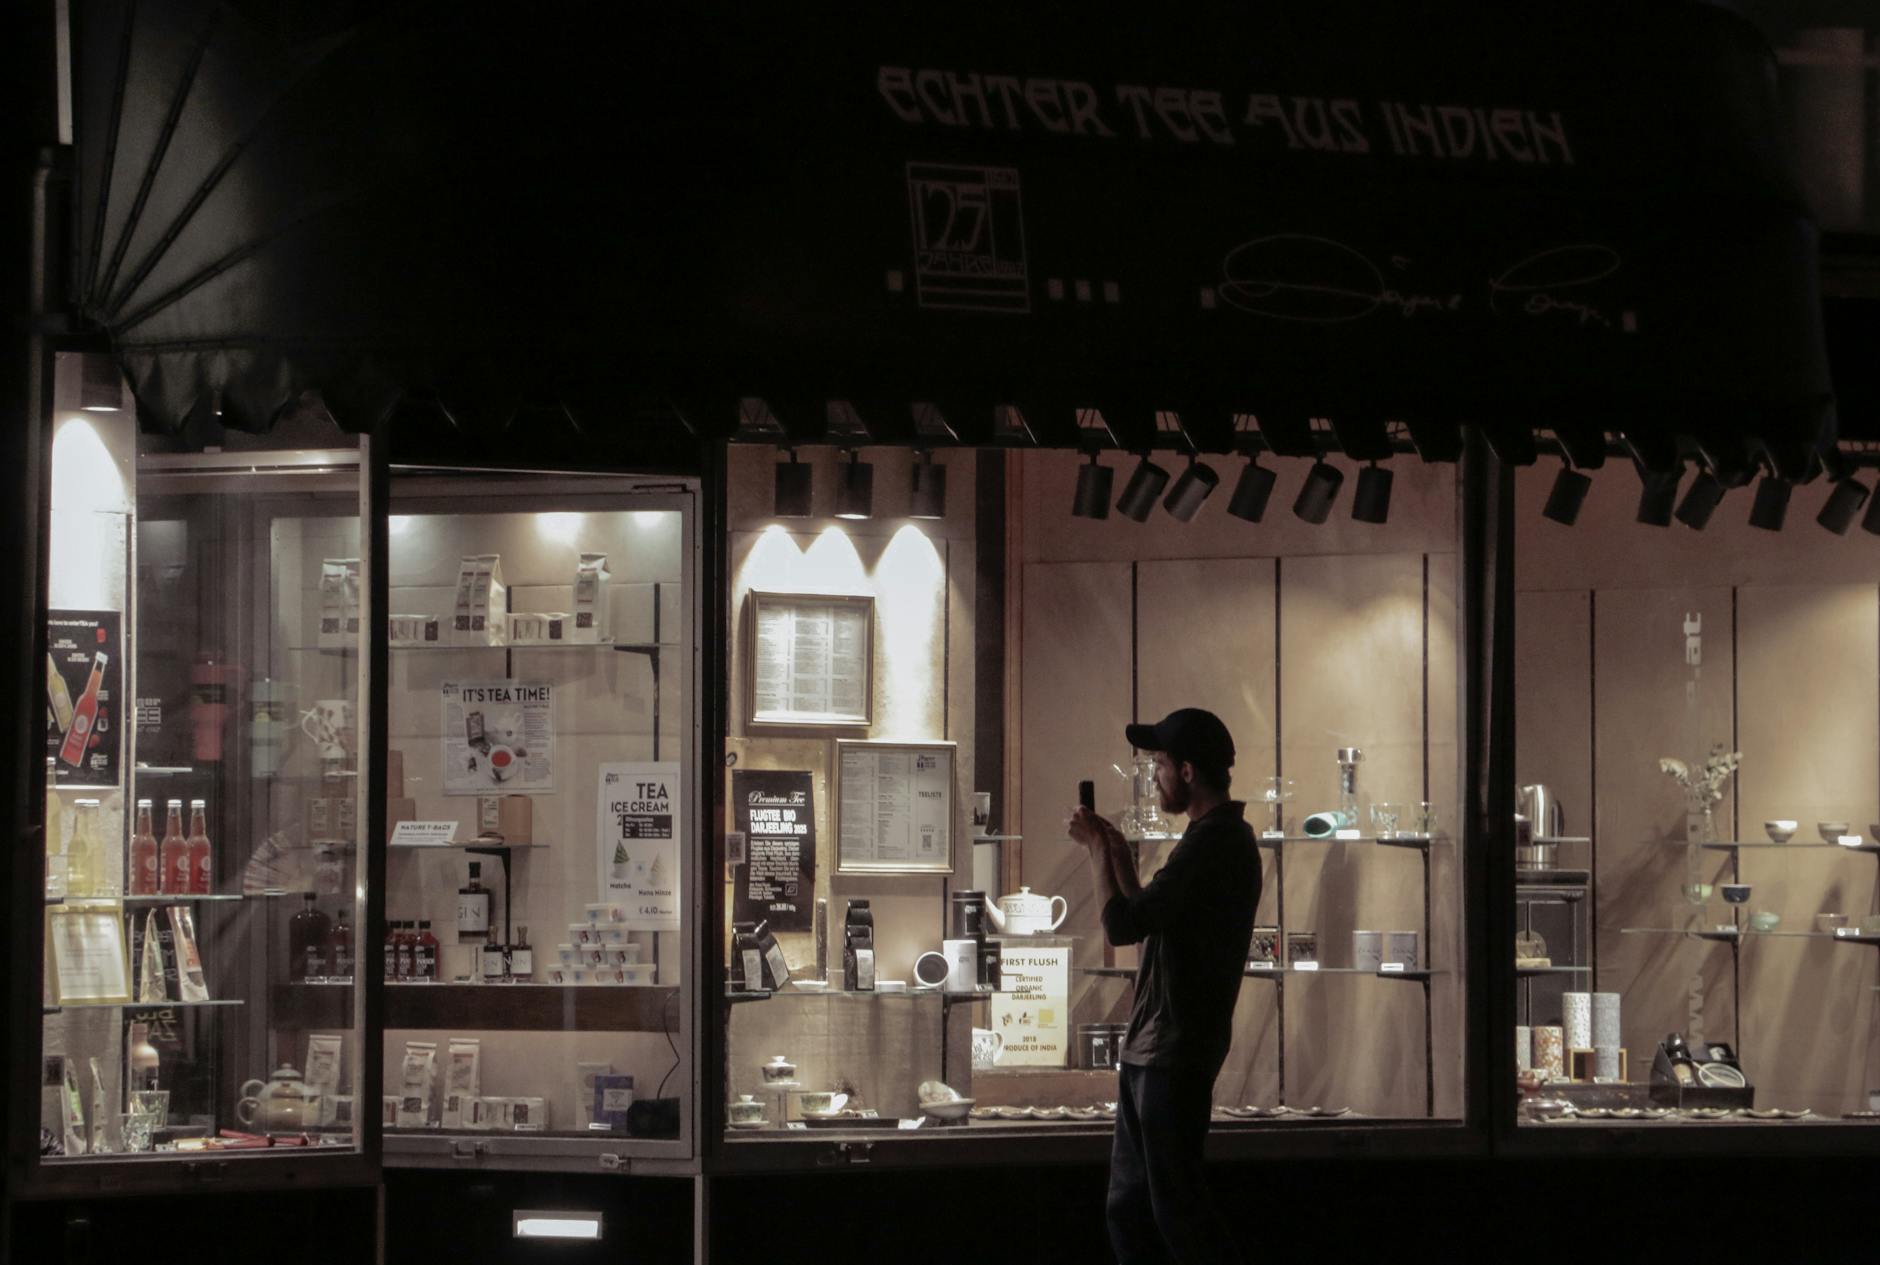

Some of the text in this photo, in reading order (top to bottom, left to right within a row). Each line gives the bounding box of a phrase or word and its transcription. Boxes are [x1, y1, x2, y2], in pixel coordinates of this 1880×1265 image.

[878, 65, 1575, 166] ECHTER TEE AUS INDIEN
[463, 688, 485, 702] IT'S
[488, 688, 511, 702] TEA
[515, 687, 550, 701] TIME!
[636, 783, 669, 799] TEA
[749, 790, 788, 804] Premium
[611, 801, 669, 812] ICE CREAM
[750, 809, 781, 821] FLUGTEE
[751, 821, 793, 834] DARJEELING
[1028, 958, 1058, 967] FLUSH
